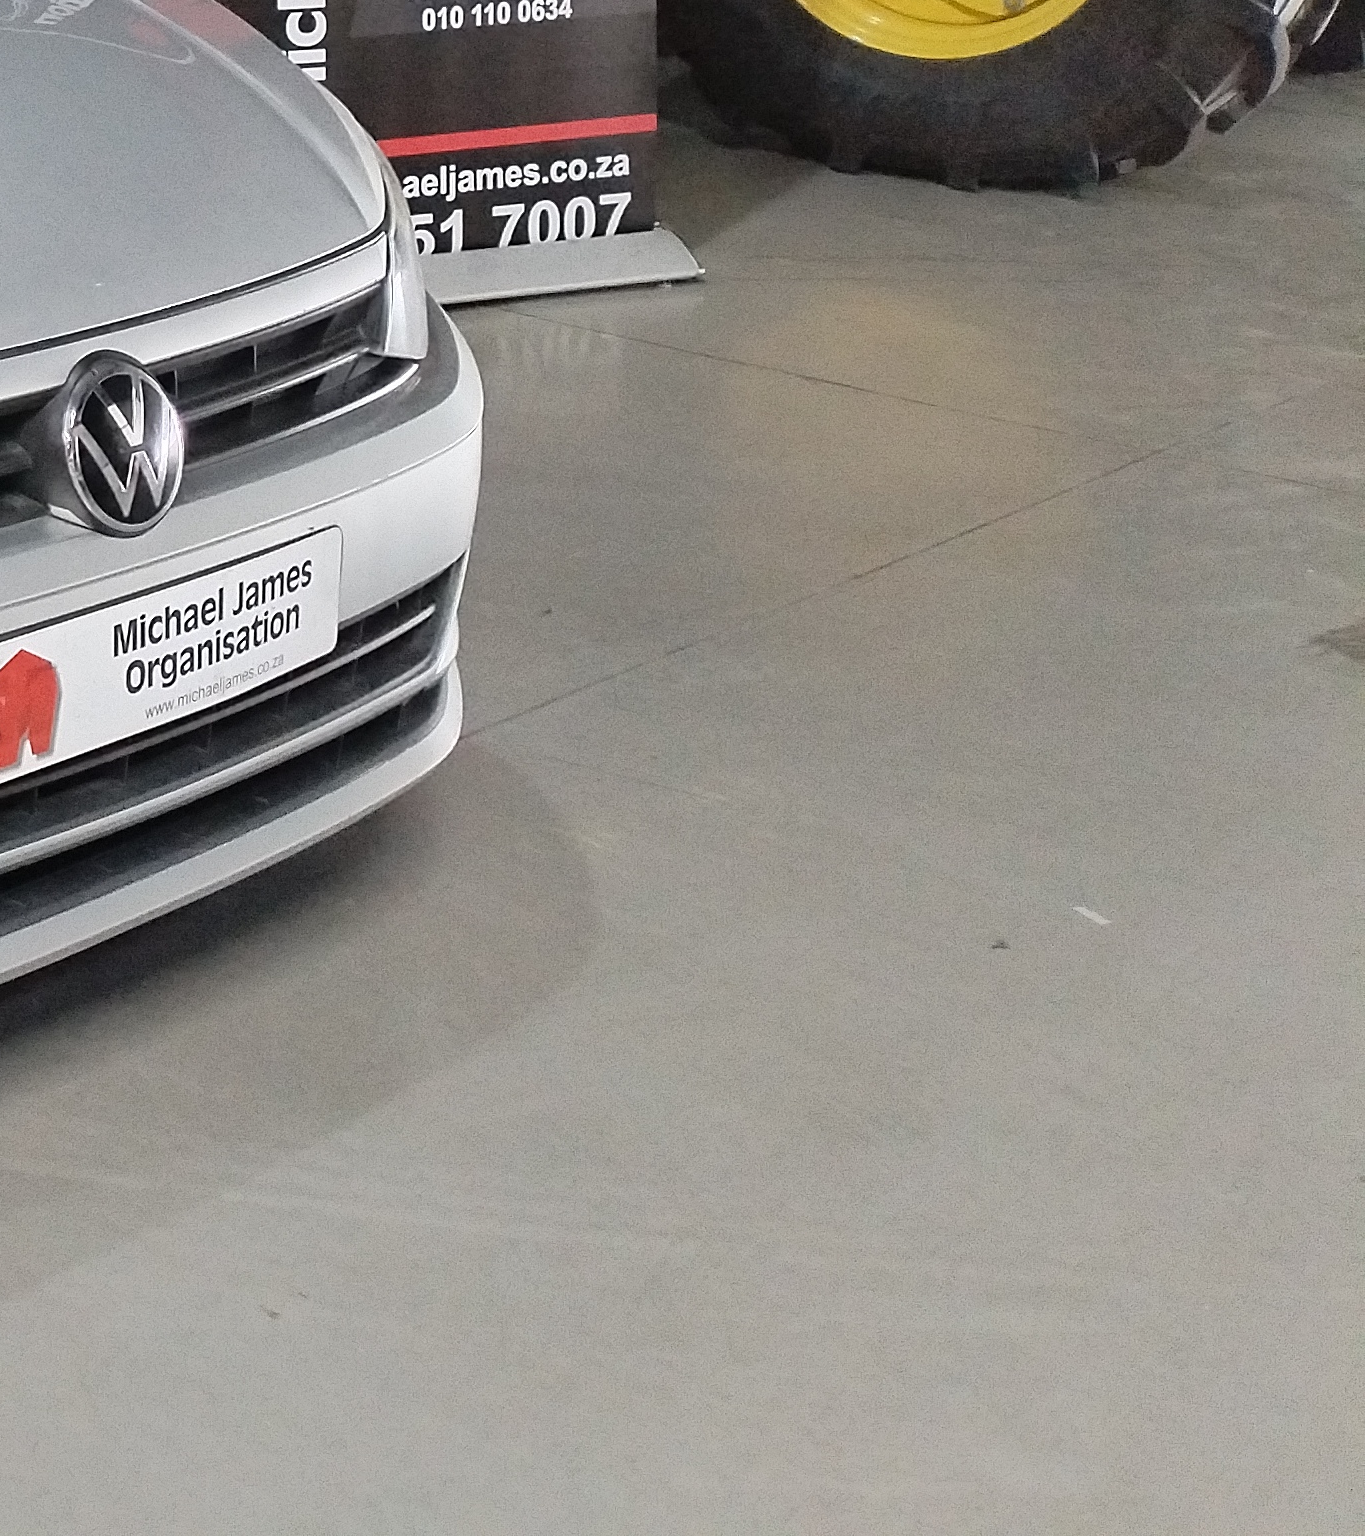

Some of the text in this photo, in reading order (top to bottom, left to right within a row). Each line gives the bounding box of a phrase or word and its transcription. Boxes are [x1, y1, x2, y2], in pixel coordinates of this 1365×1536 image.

[422, 5, 464, 31] 010
[471, 1, 510, 26] 110
[492, 192, 632, 248] 7007
[113, 560, 313, 658] Michael James
[125, 604, 300, 694] Organisation
